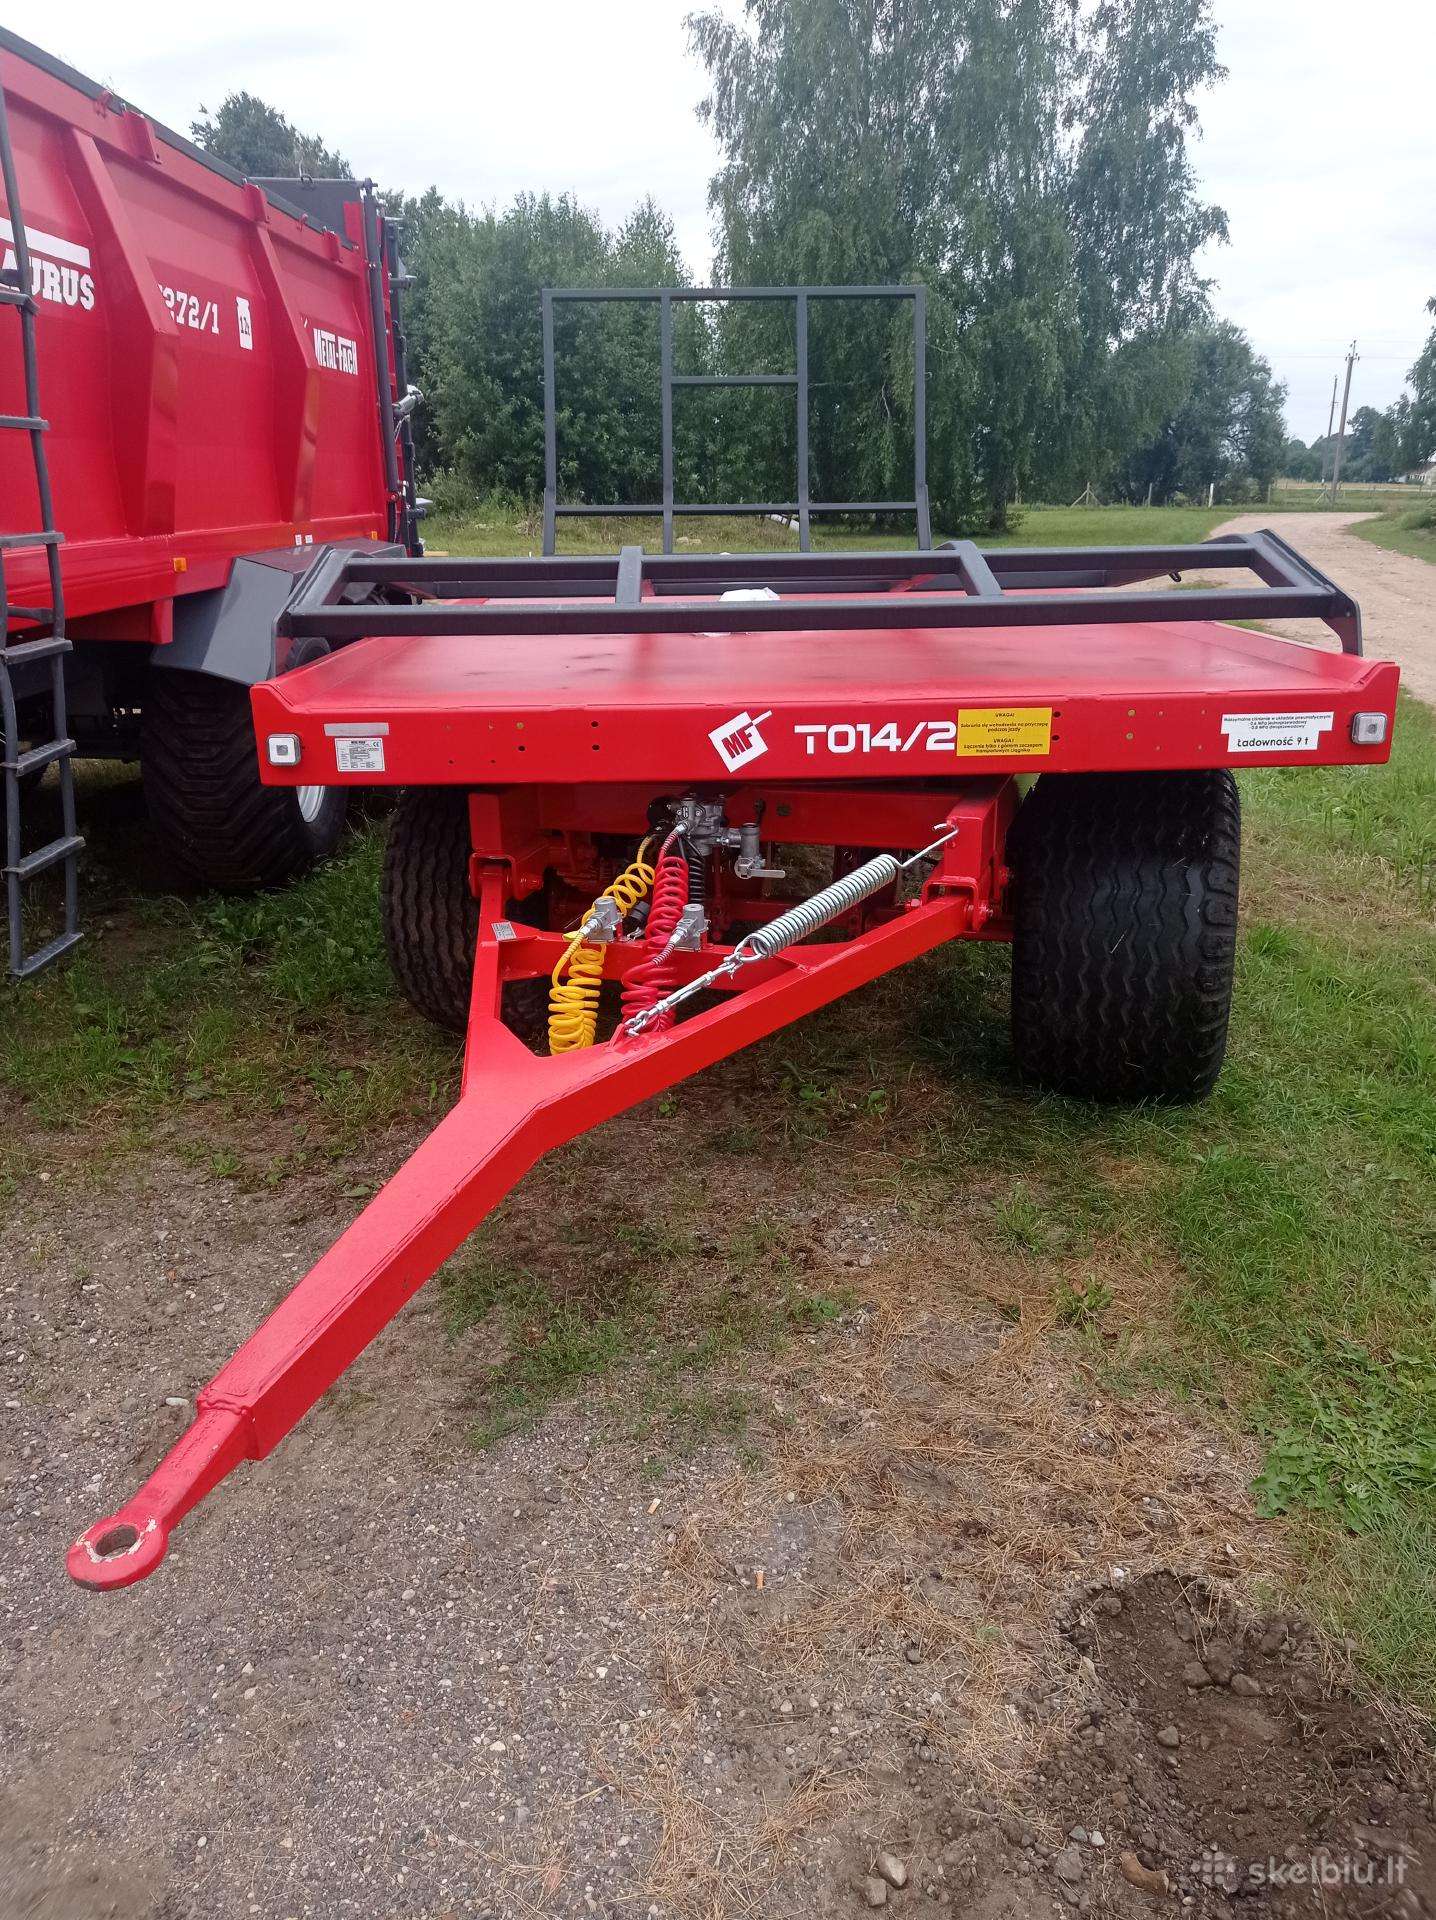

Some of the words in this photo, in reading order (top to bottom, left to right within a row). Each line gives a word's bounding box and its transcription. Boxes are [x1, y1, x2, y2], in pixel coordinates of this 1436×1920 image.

[157, 283, 219, 335] 272/1
[1237, 736, 1294, 747] Ładowność
[1296, 737, 1302, 746] 9
[1304, 737, 1309, 745] t
